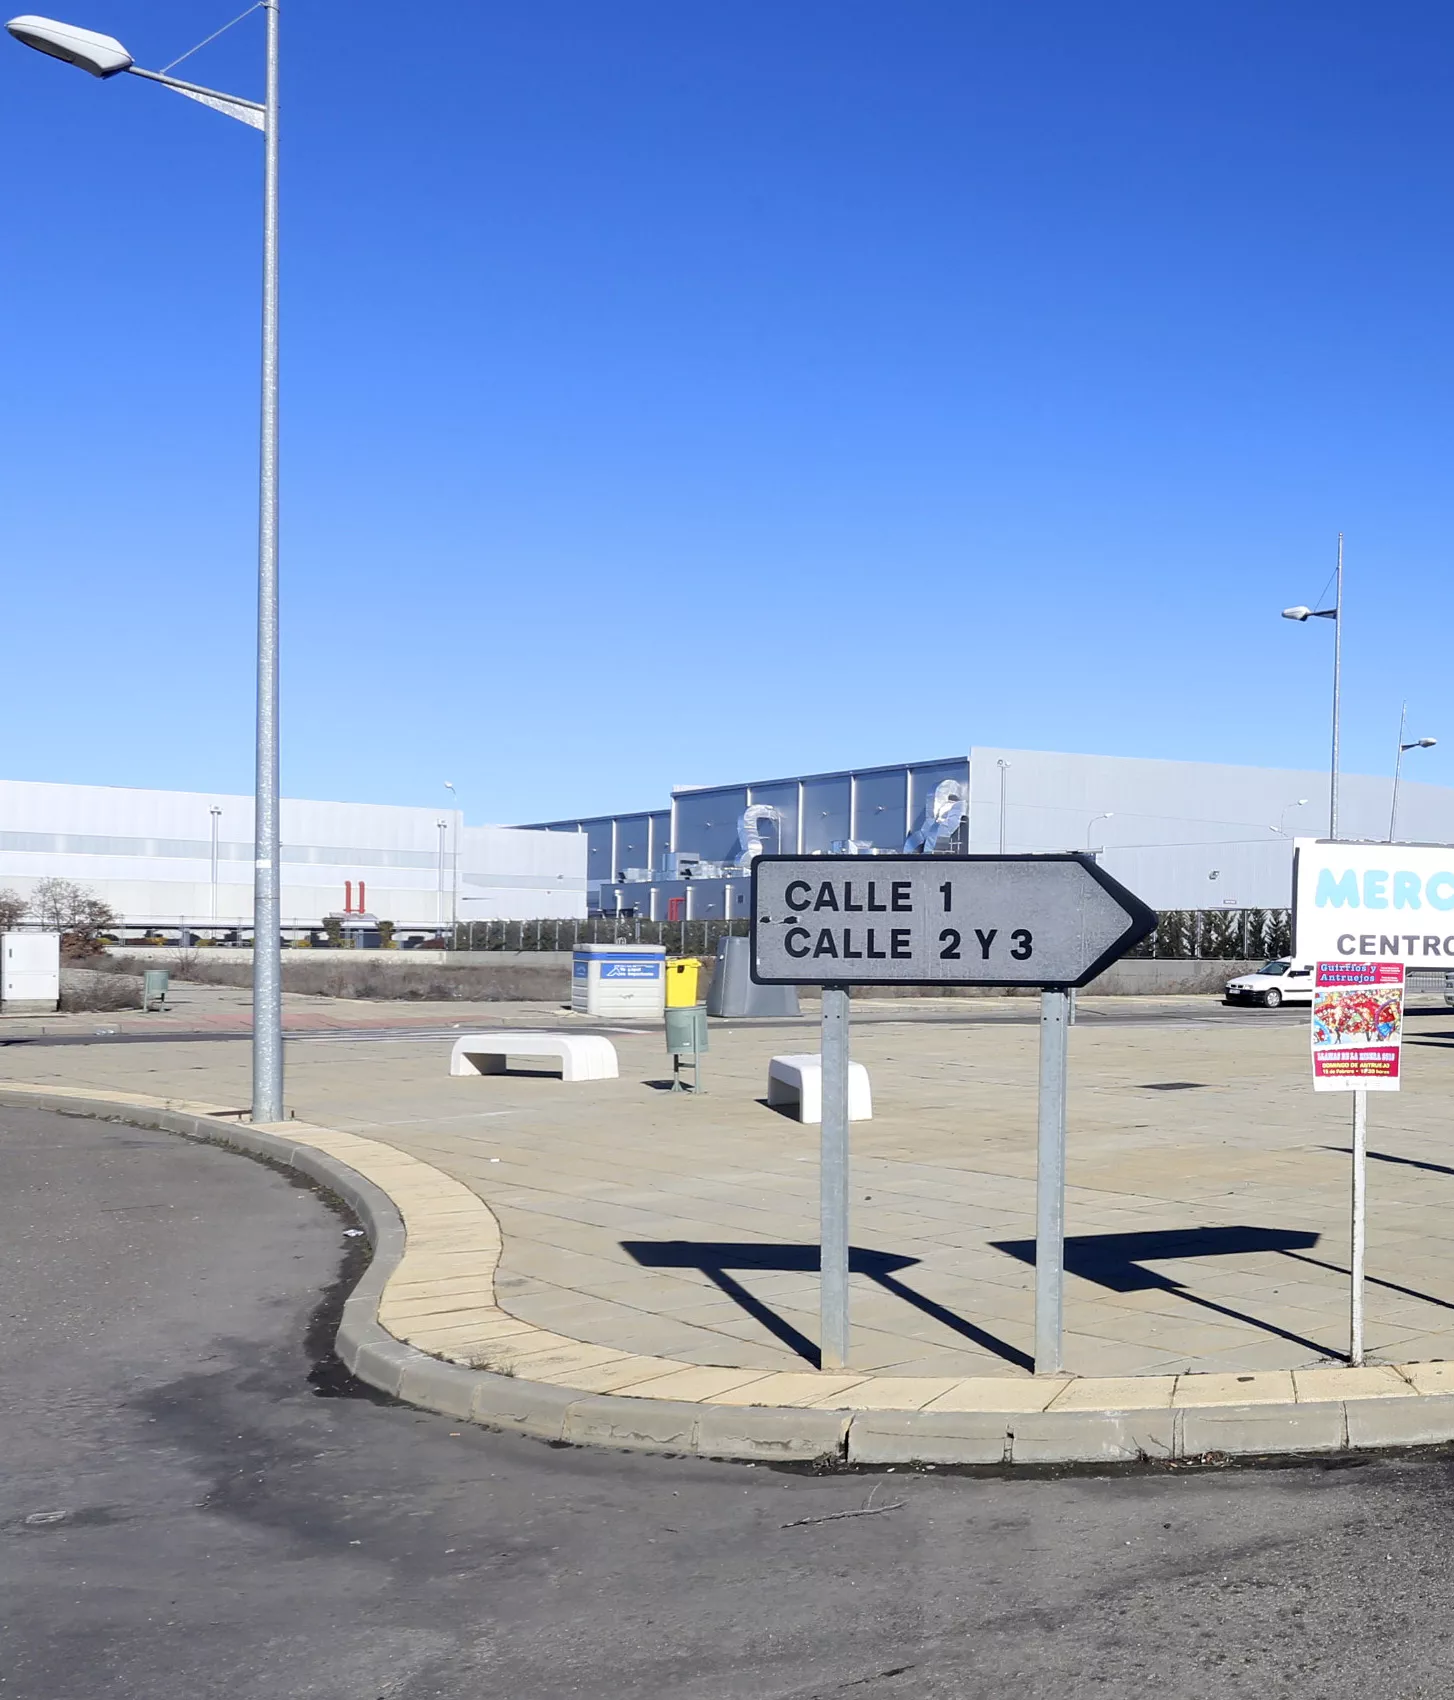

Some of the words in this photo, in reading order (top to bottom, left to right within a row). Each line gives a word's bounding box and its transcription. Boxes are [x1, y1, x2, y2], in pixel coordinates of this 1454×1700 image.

[784, 880, 913, 912] CALLE
[939, 881, 953, 912] 1
[784, 927, 912, 959] CALLE
[939, 928, 961, 960] 2
[975, 928, 998, 960] Y
[1010, 928, 1033, 960] 3
[1319, 973, 1375, 983] Antruejos
[1370, 965, 1377, 974] y
